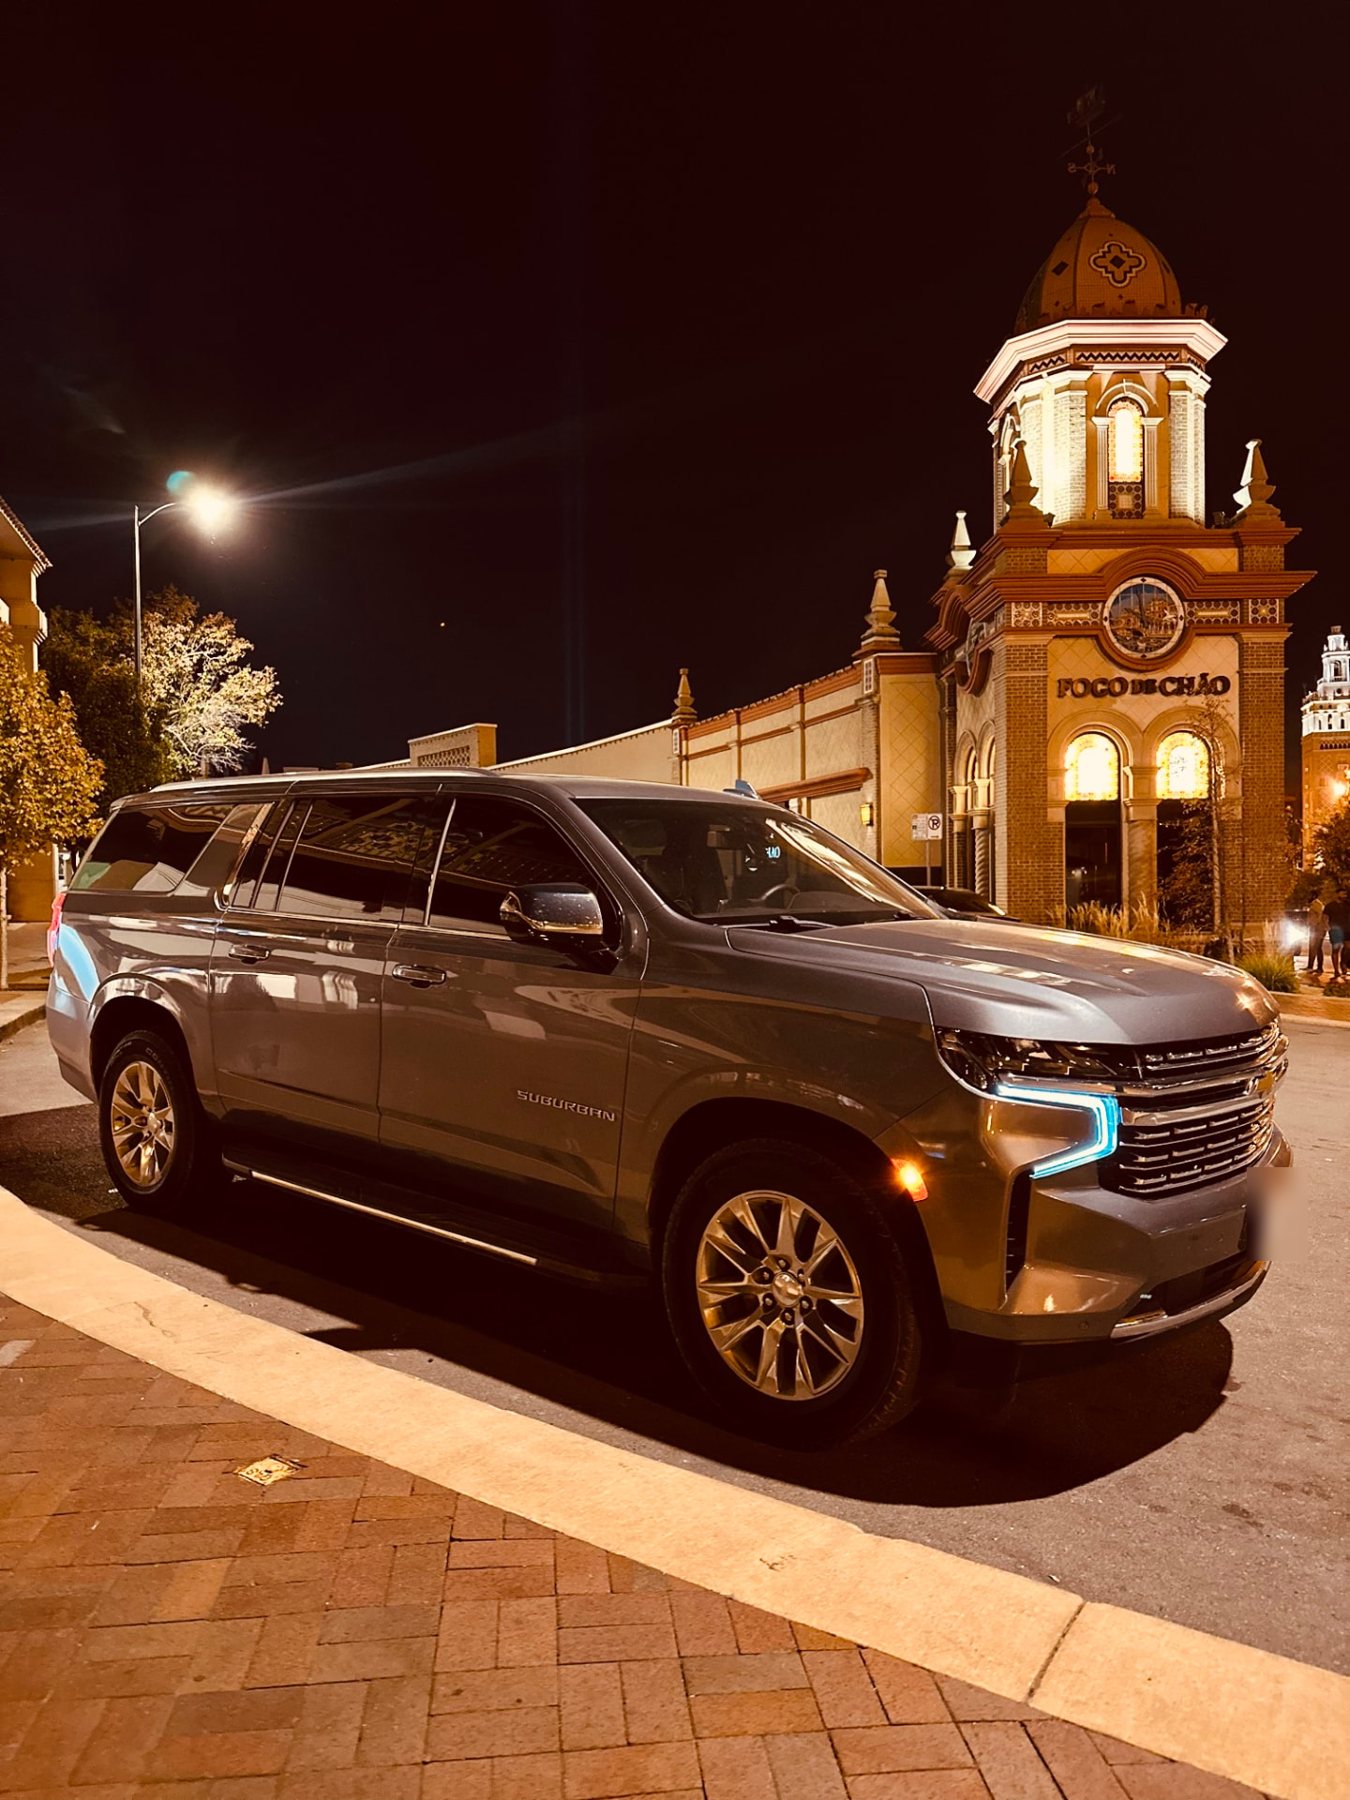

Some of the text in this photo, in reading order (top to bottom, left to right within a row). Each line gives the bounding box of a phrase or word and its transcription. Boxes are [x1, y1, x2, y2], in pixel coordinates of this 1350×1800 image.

[1057, 676, 1129, 699] FOGO
[1130, 678, 1158, 695] DE
[516, 1089, 616, 1122] SUBURBAN
